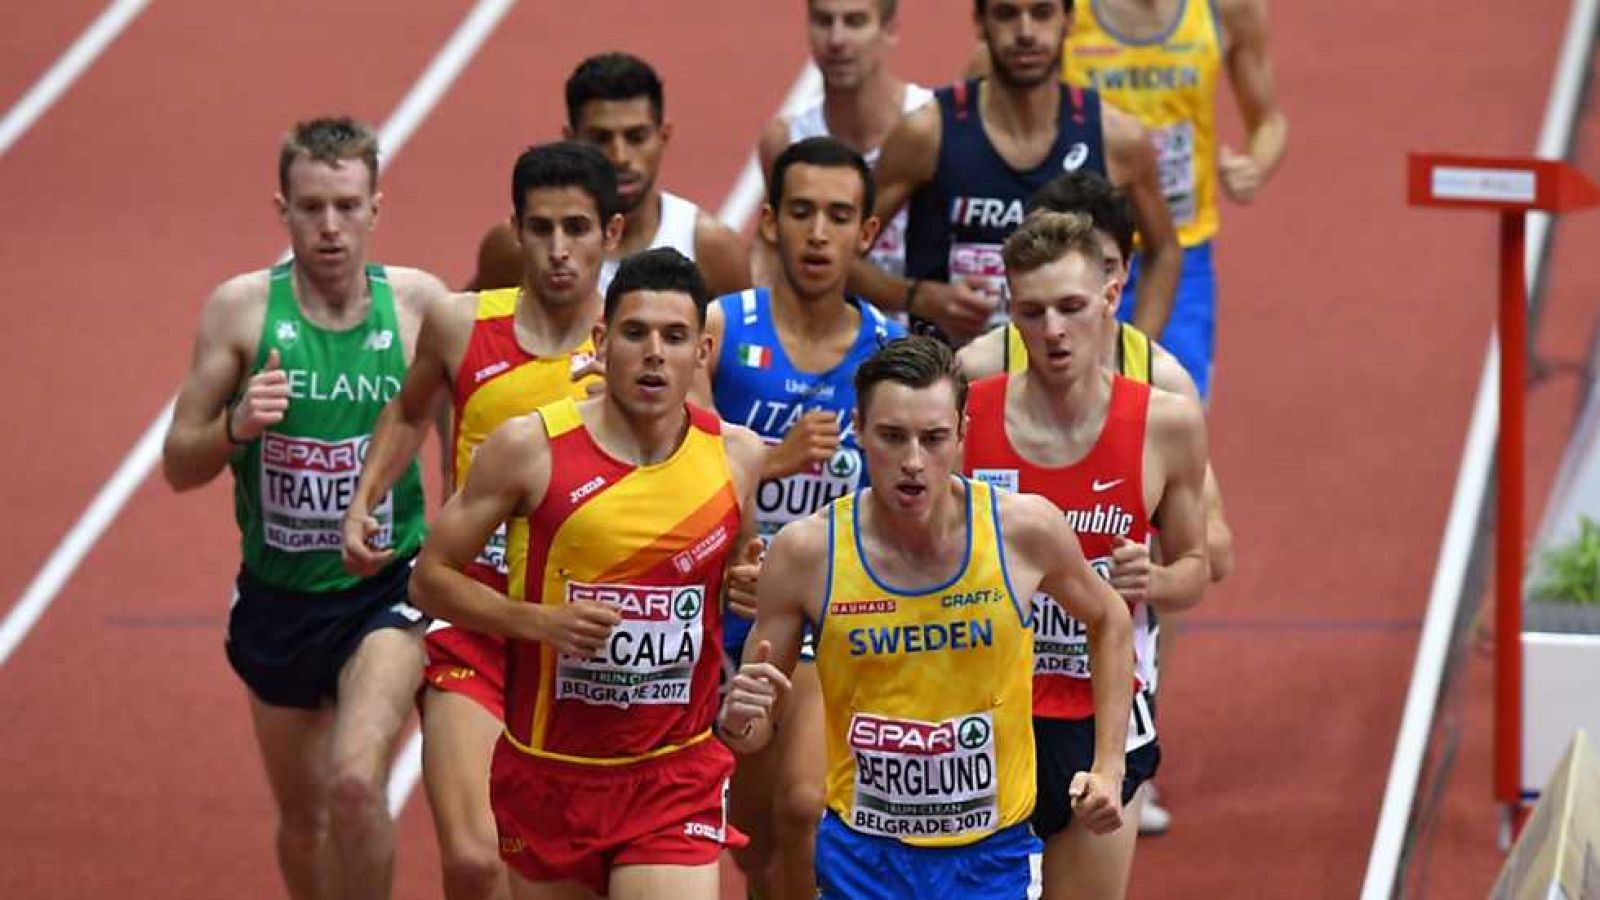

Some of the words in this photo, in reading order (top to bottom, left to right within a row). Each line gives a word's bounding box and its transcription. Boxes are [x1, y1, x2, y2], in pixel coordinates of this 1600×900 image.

[287, 370, 401, 402] ELAND
[264, 441, 351, 468] SPAR
[265, 469, 386, 511] TRAVE
[1067, 505, 1133, 535] public
[267, 530, 341, 547] BELGRAD
[848, 618, 993, 656] SWEDEN
[652, 684, 688, 699] 2017
[852, 720, 952, 750] SPAR
[856, 752, 993, 796] BERGLUND
[855, 811, 951, 834] BELGRADE
[957, 810, 993, 832] 2017
